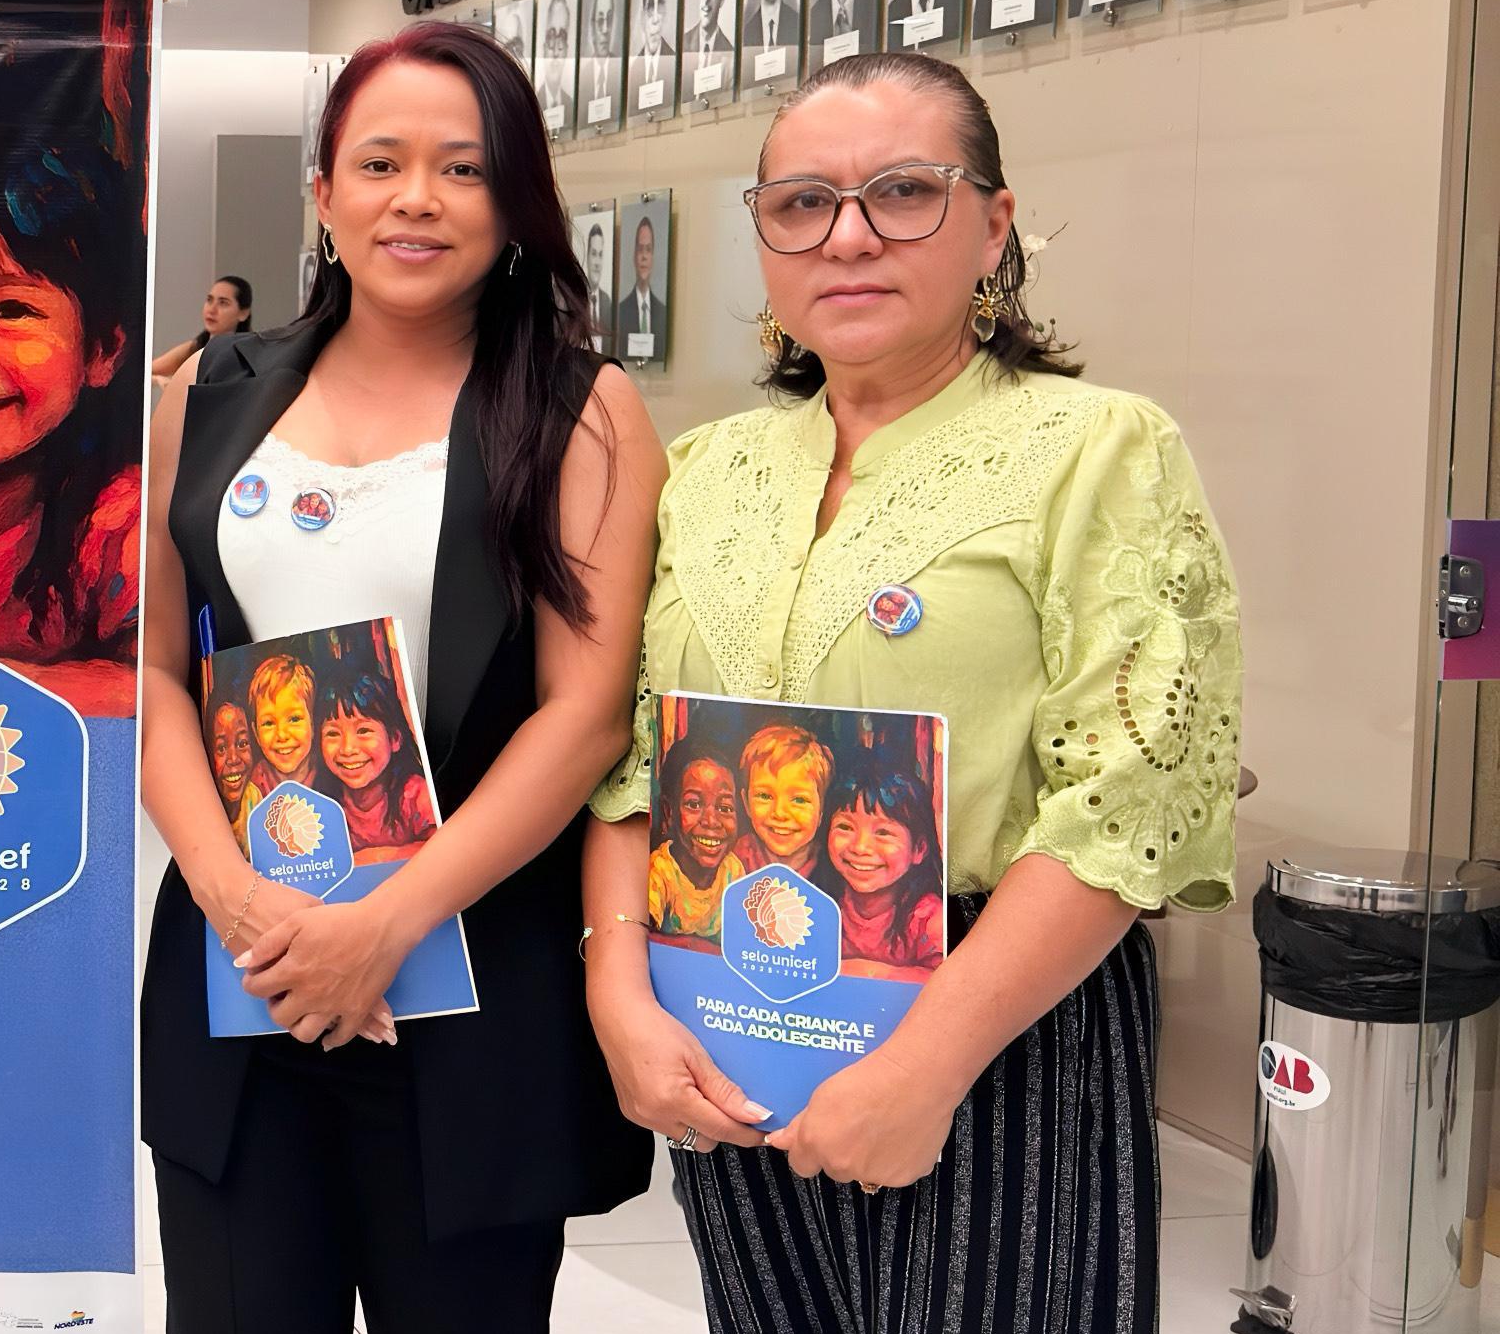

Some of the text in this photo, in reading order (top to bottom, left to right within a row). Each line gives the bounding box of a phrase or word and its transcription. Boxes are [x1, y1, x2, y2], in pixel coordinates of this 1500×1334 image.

[270, 858, 334, 876] selo unicef
[741, 949, 817, 970] selo unicef
[696, 995, 875, 1038] PARA CADA CRIANÇA E
[703, 1014, 865, 1054] CADA ADOLESCENTE
[1261, 1045, 1314, 1094] OAB
